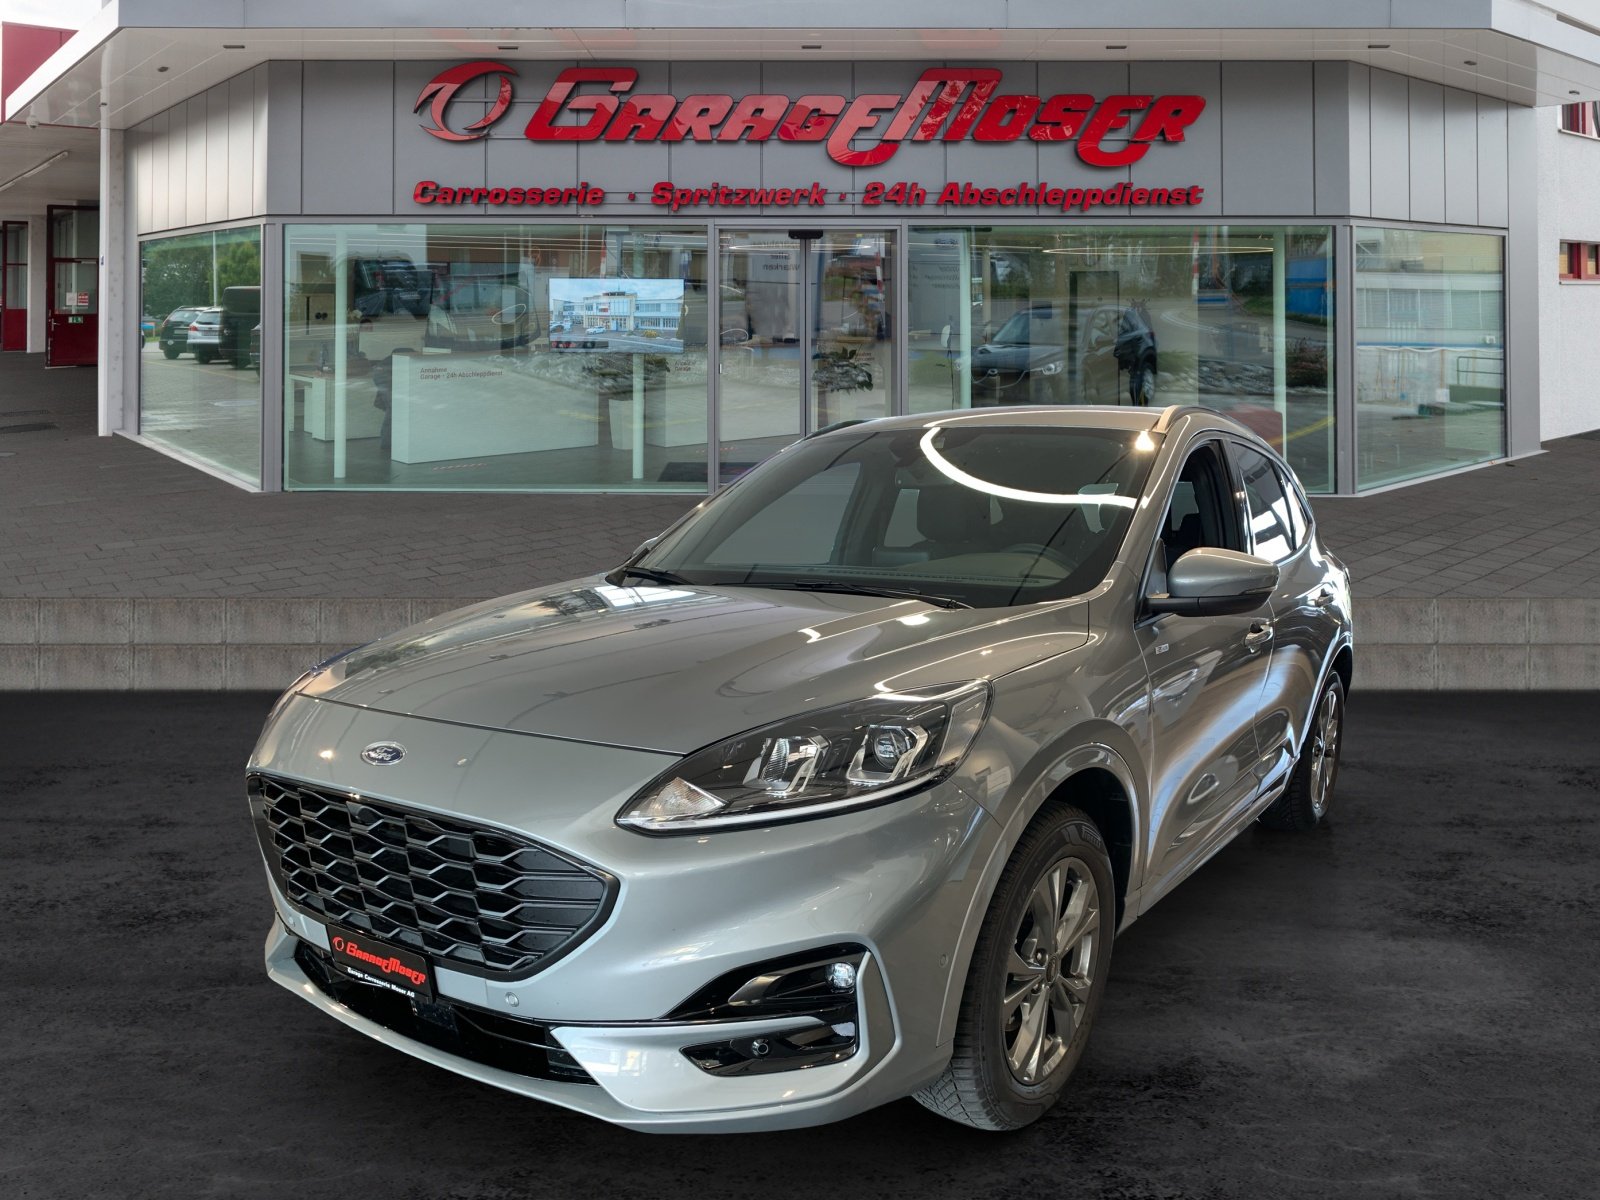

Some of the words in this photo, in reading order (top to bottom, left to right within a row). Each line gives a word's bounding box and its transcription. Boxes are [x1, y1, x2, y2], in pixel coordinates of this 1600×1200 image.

[413, 180, 604, 206] Carrosserie
[651, 182, 826, 212] Spritzwerk
[863, 182, 926, 206] 24h
[938, 183, 1204, 212] Abschleppdienst
[347, 967, 363, 978] Garage
[391, 984, 406, 995] Moser
